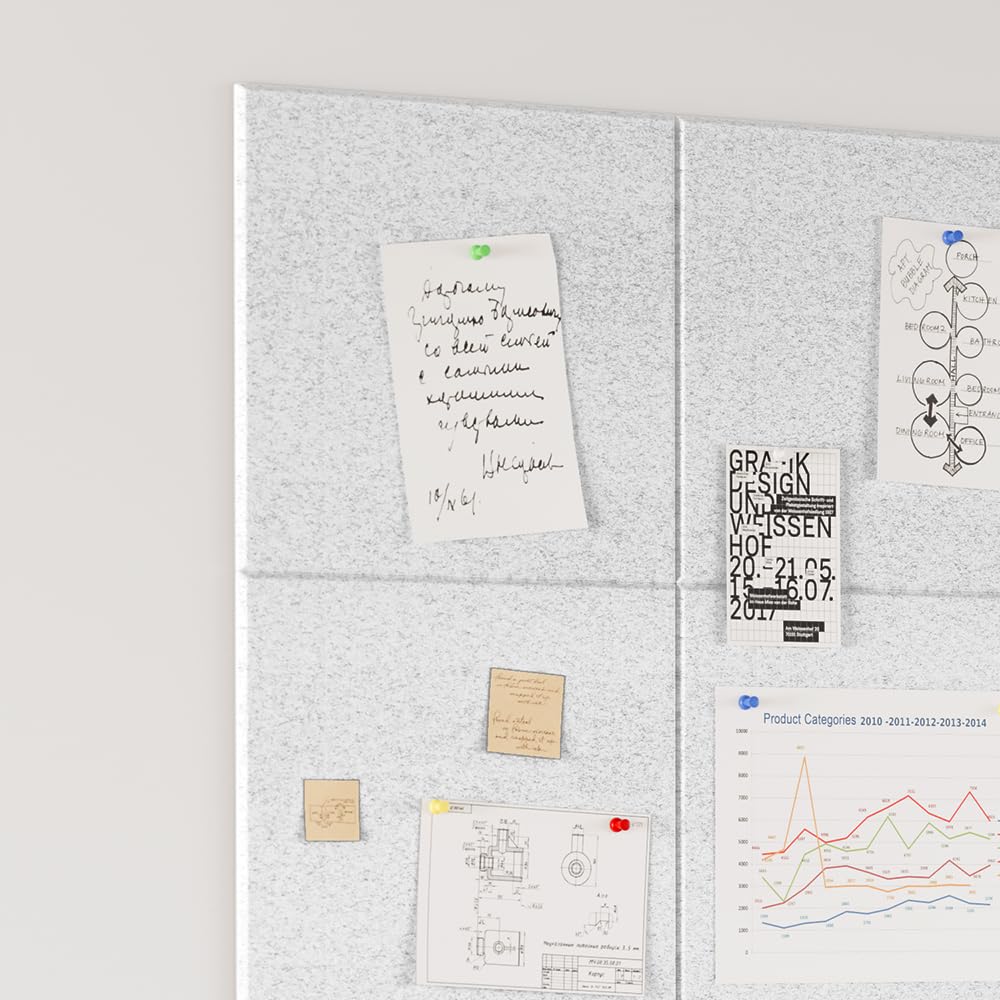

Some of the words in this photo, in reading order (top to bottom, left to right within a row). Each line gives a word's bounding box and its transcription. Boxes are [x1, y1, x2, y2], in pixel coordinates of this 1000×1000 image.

[956, 251, 979, 261] PORCH
[962, 294, 998, 305] KITCHEN
[960, 437, 984, 447] OFFICE
[730, 534, 773, 557] HOF
[763, 712, 801, 725] Product
[804, 713, 857, 728] Categories
[860, 716, 883, 726] 2010
